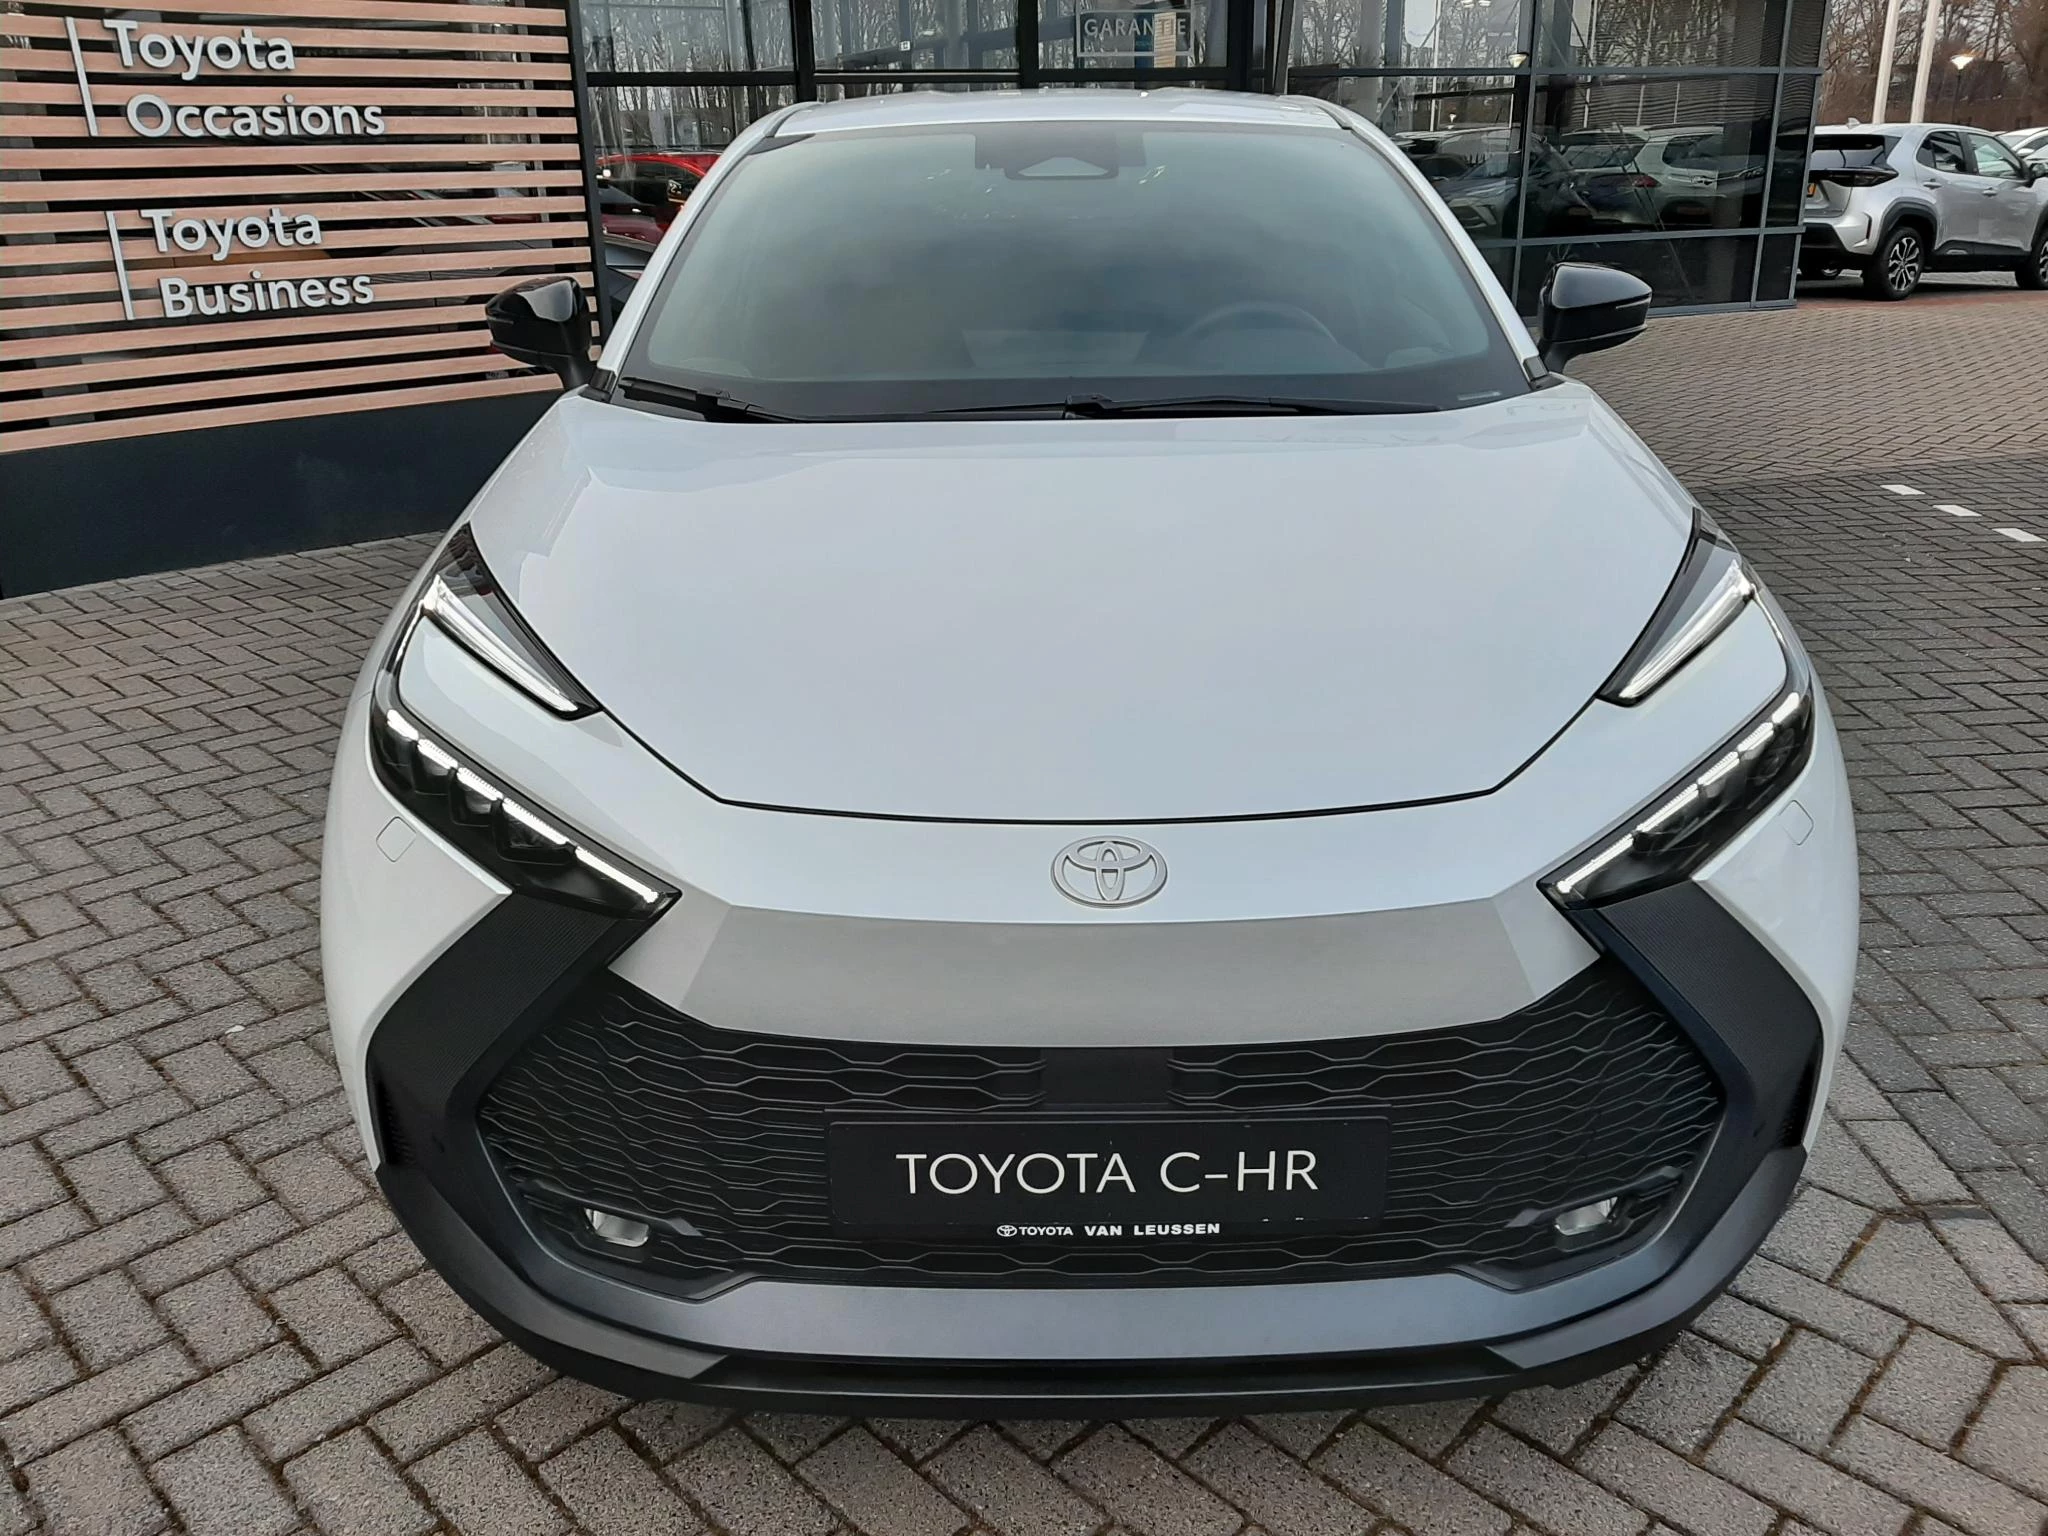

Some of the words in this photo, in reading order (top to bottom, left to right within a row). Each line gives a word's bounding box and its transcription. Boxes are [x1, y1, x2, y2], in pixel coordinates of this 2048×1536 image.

[104, 18, 296, 81] Toyota
[1084, 18, 1187, 36] GARANTIE
[126, 94, 386, 138] Occasions
[140, 207, 323, 262] Toyota
[158, 270, 375, 319] Business
[896, 1152, 1137, 1195] TOYOTA
[1159, 1149, 1320, 1192] C-HR
[1018, 1225, 1074, 1236] TOYOTA
[1084, 1225, 1122, 1236] VAN
[1133, 1223, 1221, 1236] LEUSSEN
